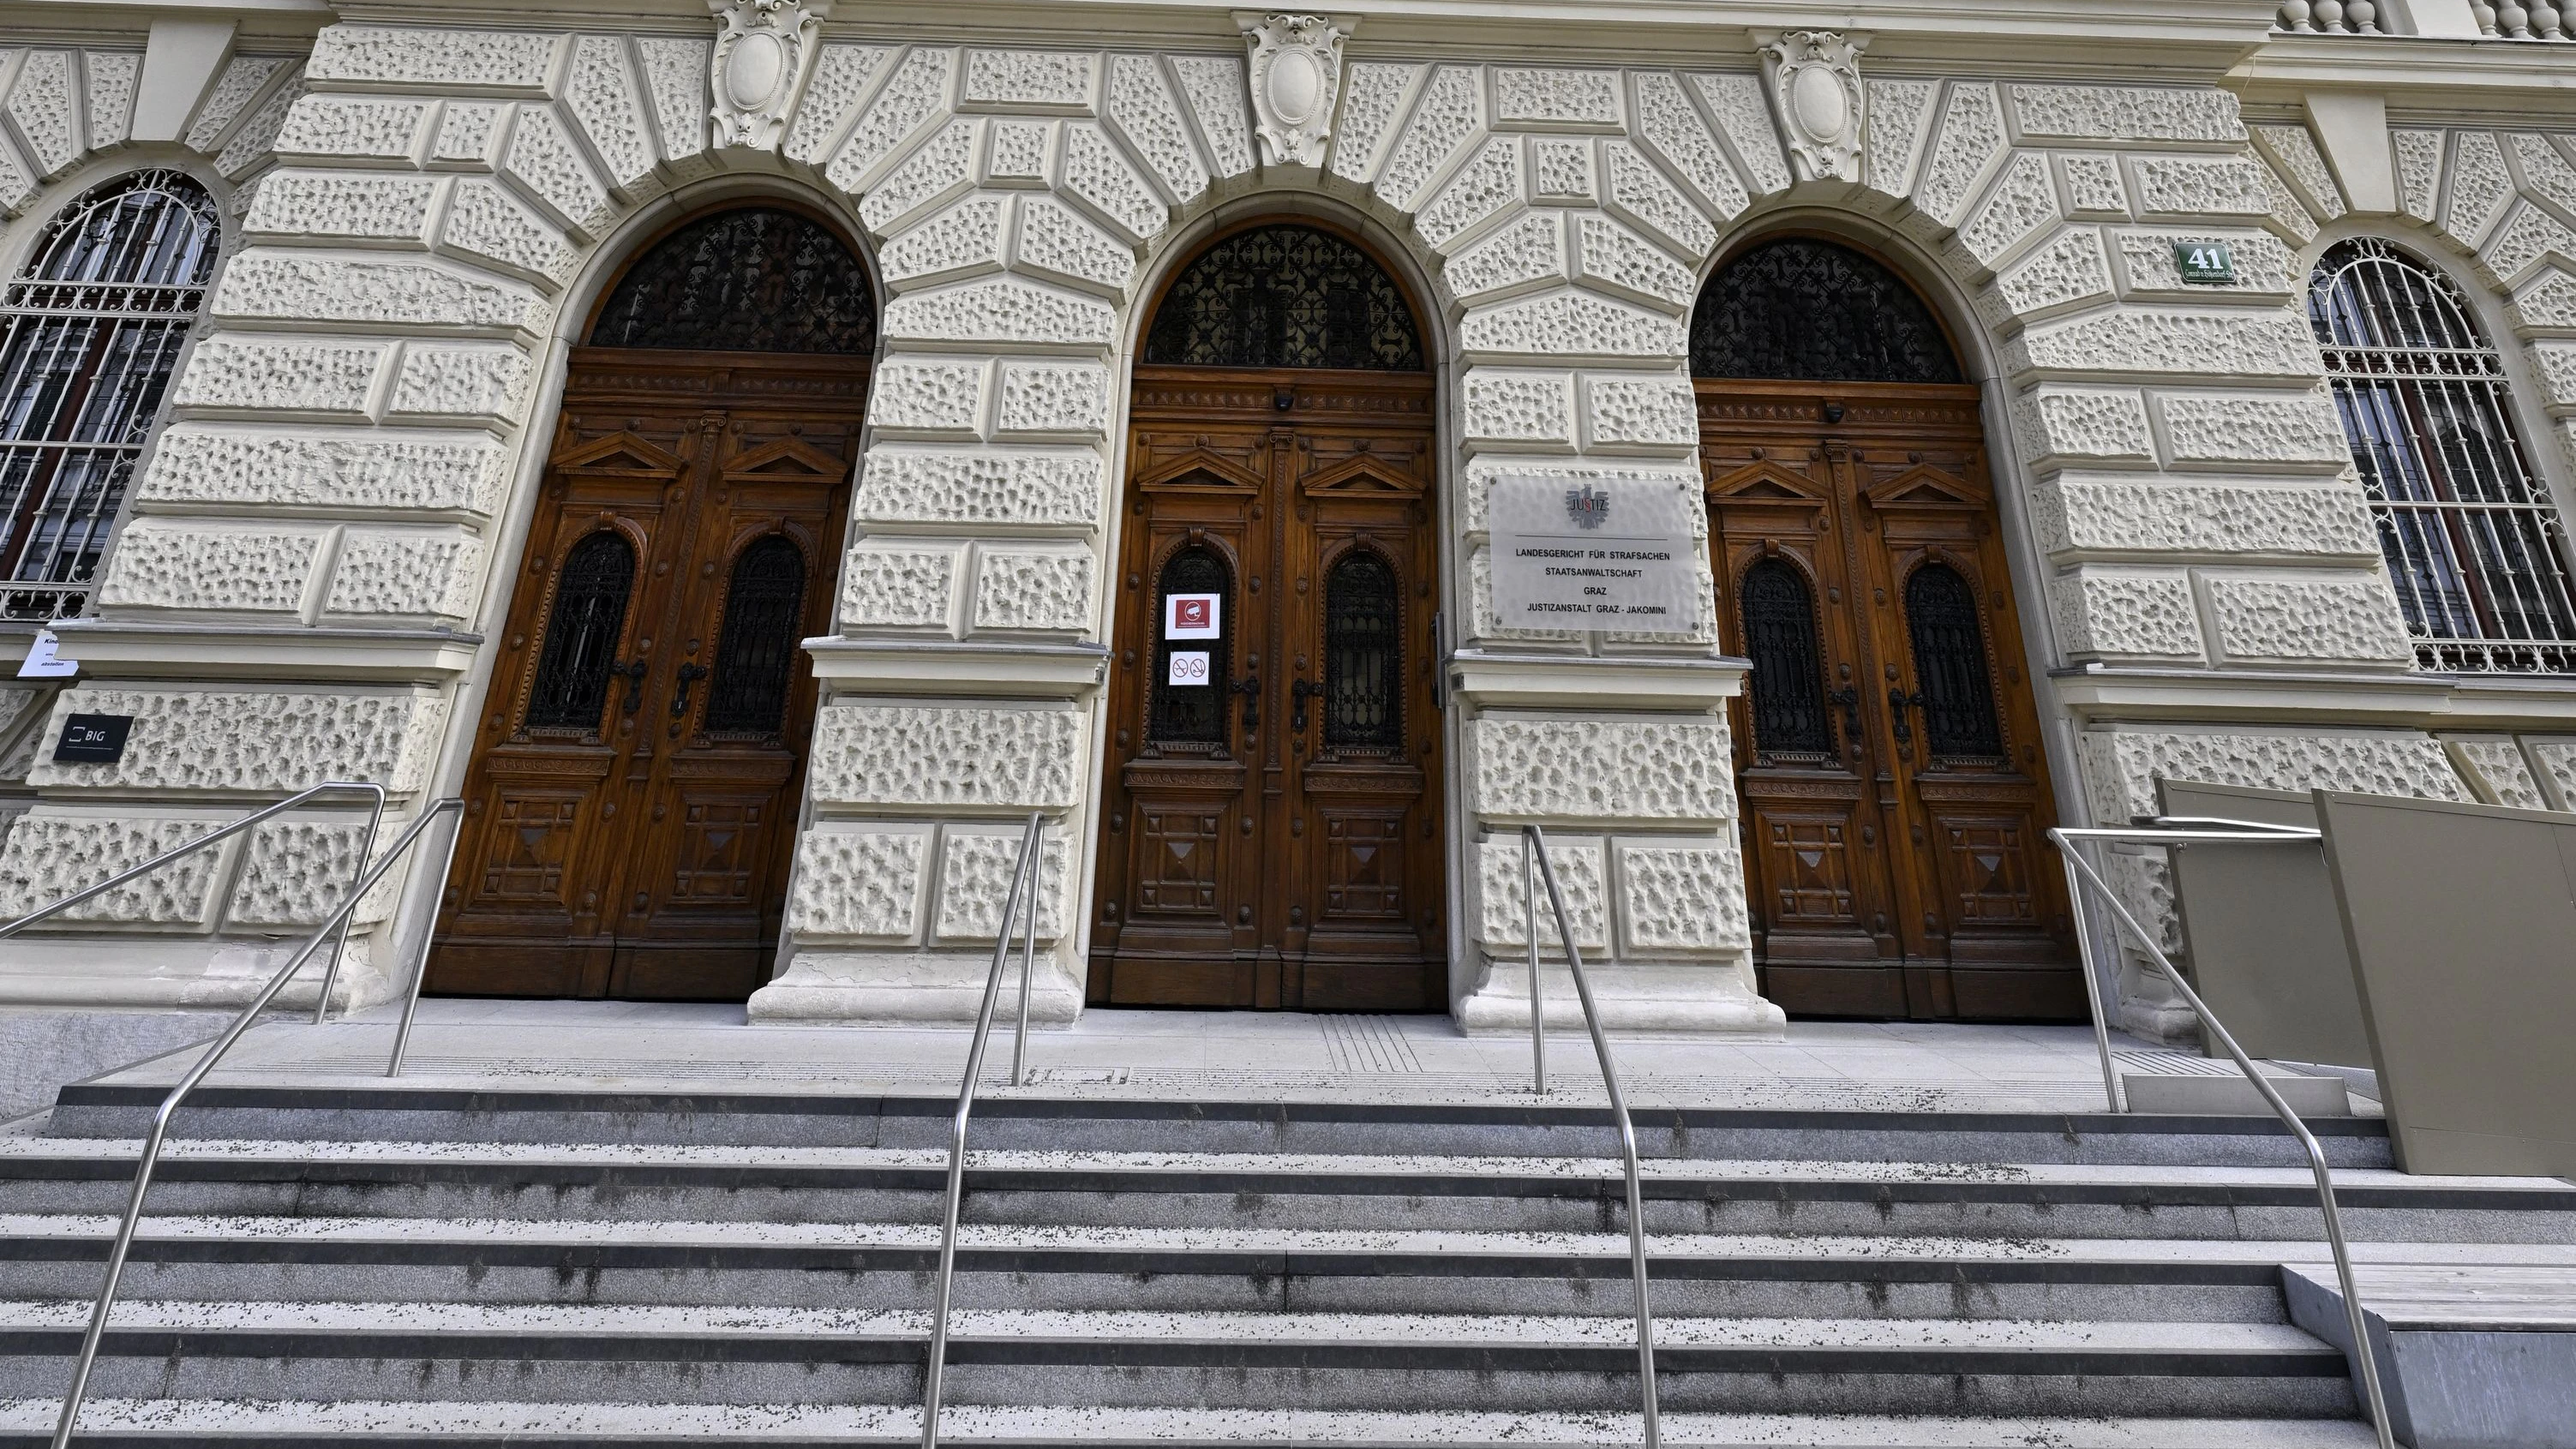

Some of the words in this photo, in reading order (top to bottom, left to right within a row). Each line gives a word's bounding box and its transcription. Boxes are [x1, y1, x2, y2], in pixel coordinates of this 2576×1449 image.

[2188, 248, 2224, 269] 41
[1516, 548, 1585, 559] LANDESGERICHT
[1589, 549, 1606, 559] FÜR
[1609, 551, 1670, 560] STRAFSACHEN
[1545, 567, 1643, 578] STAATSANWALTSCHAFT
[1584, 587, 1607, 596] GRAZ
[1527, 602, 1591, 613] JUSTIZANSTALT
[1597, 604, 1620, 614] GRAZ
[1626, 605, 1667, 614] JAKOMINI
[85, 730, 105, 741] BIG
